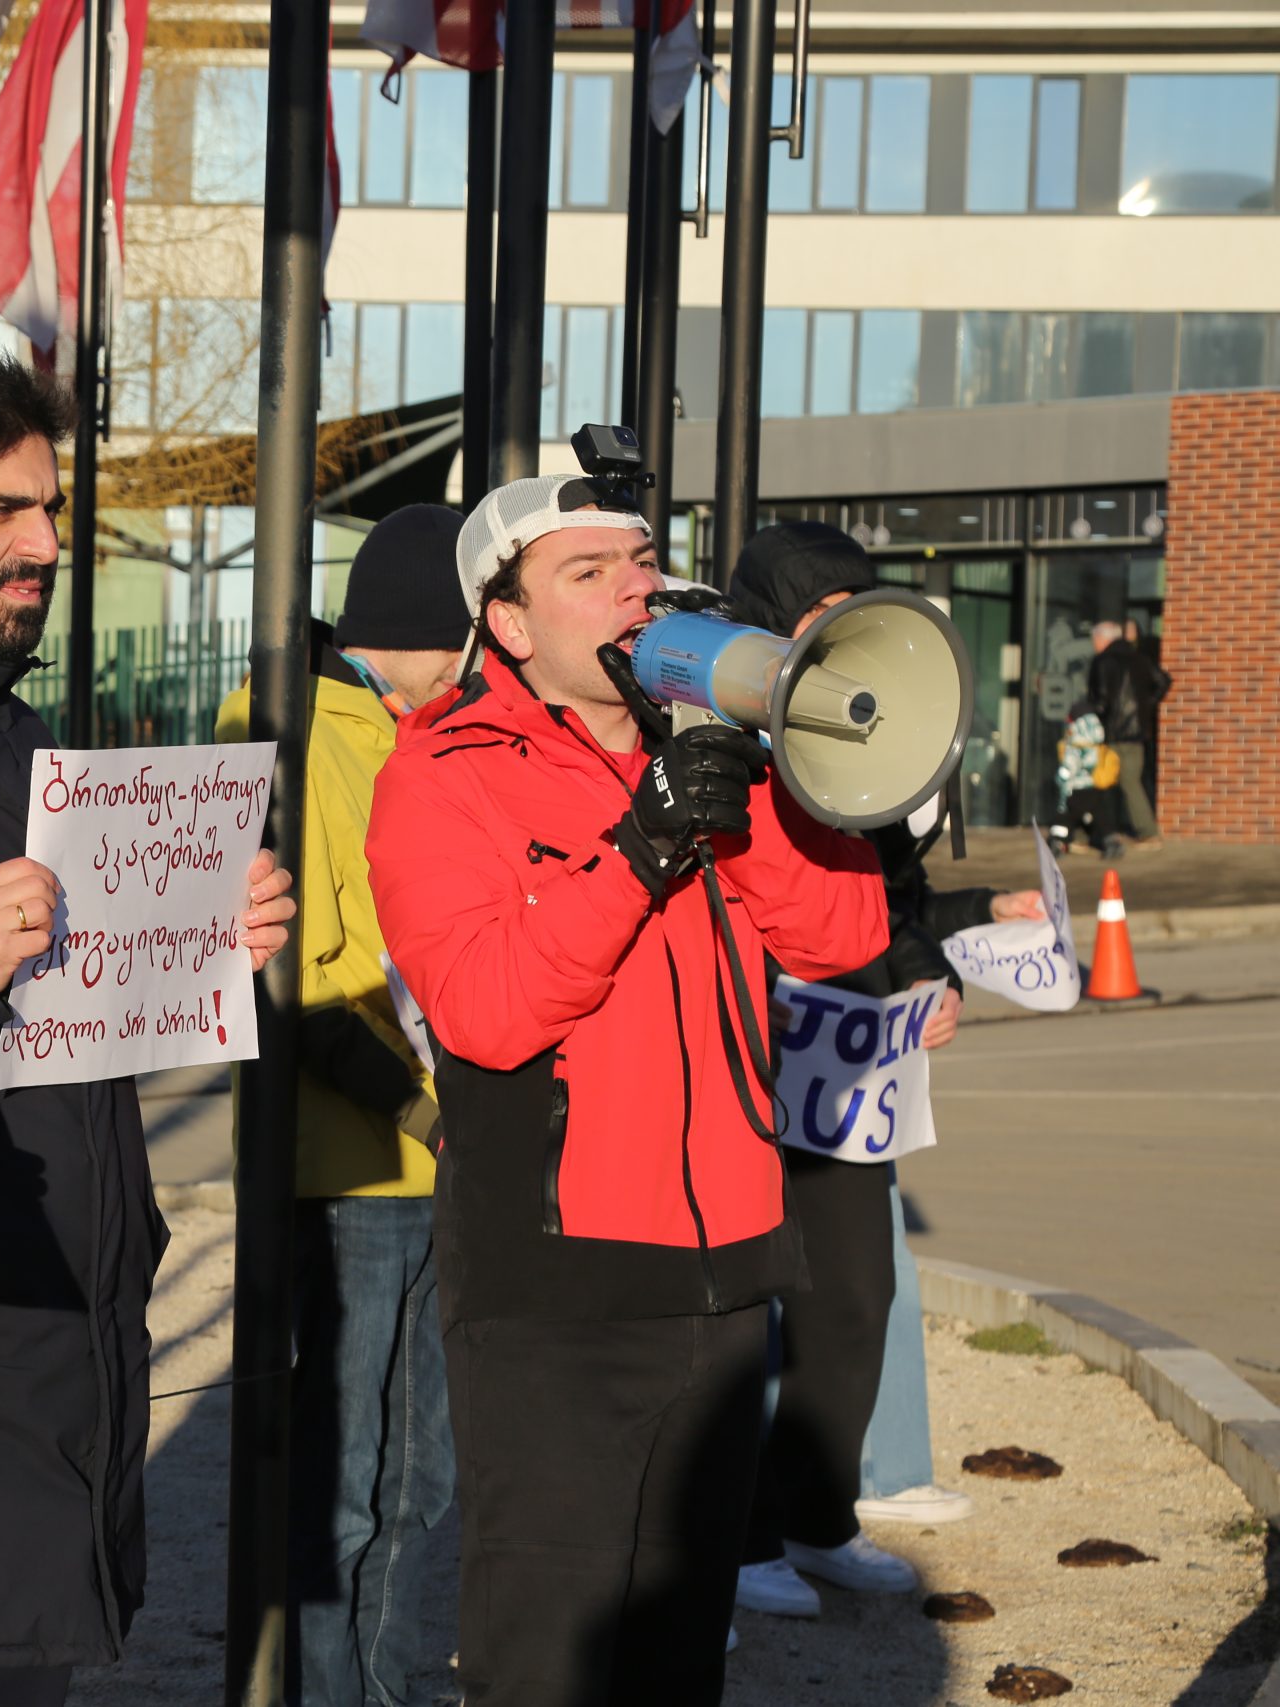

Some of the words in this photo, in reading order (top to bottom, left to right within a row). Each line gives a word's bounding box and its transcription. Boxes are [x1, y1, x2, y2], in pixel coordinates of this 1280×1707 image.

[653, 756, 675, 808] LEKI
[94, 826, 223, 896] აკადემიაში
[2, 1014, 106, 1061] ადგილი
[119, 1001, 146, 1039] არ
[157, 989, 227, 1046] არის!
[780, 991, 936, 1070] JOIN
[802, 1076, 897, 1154] US
